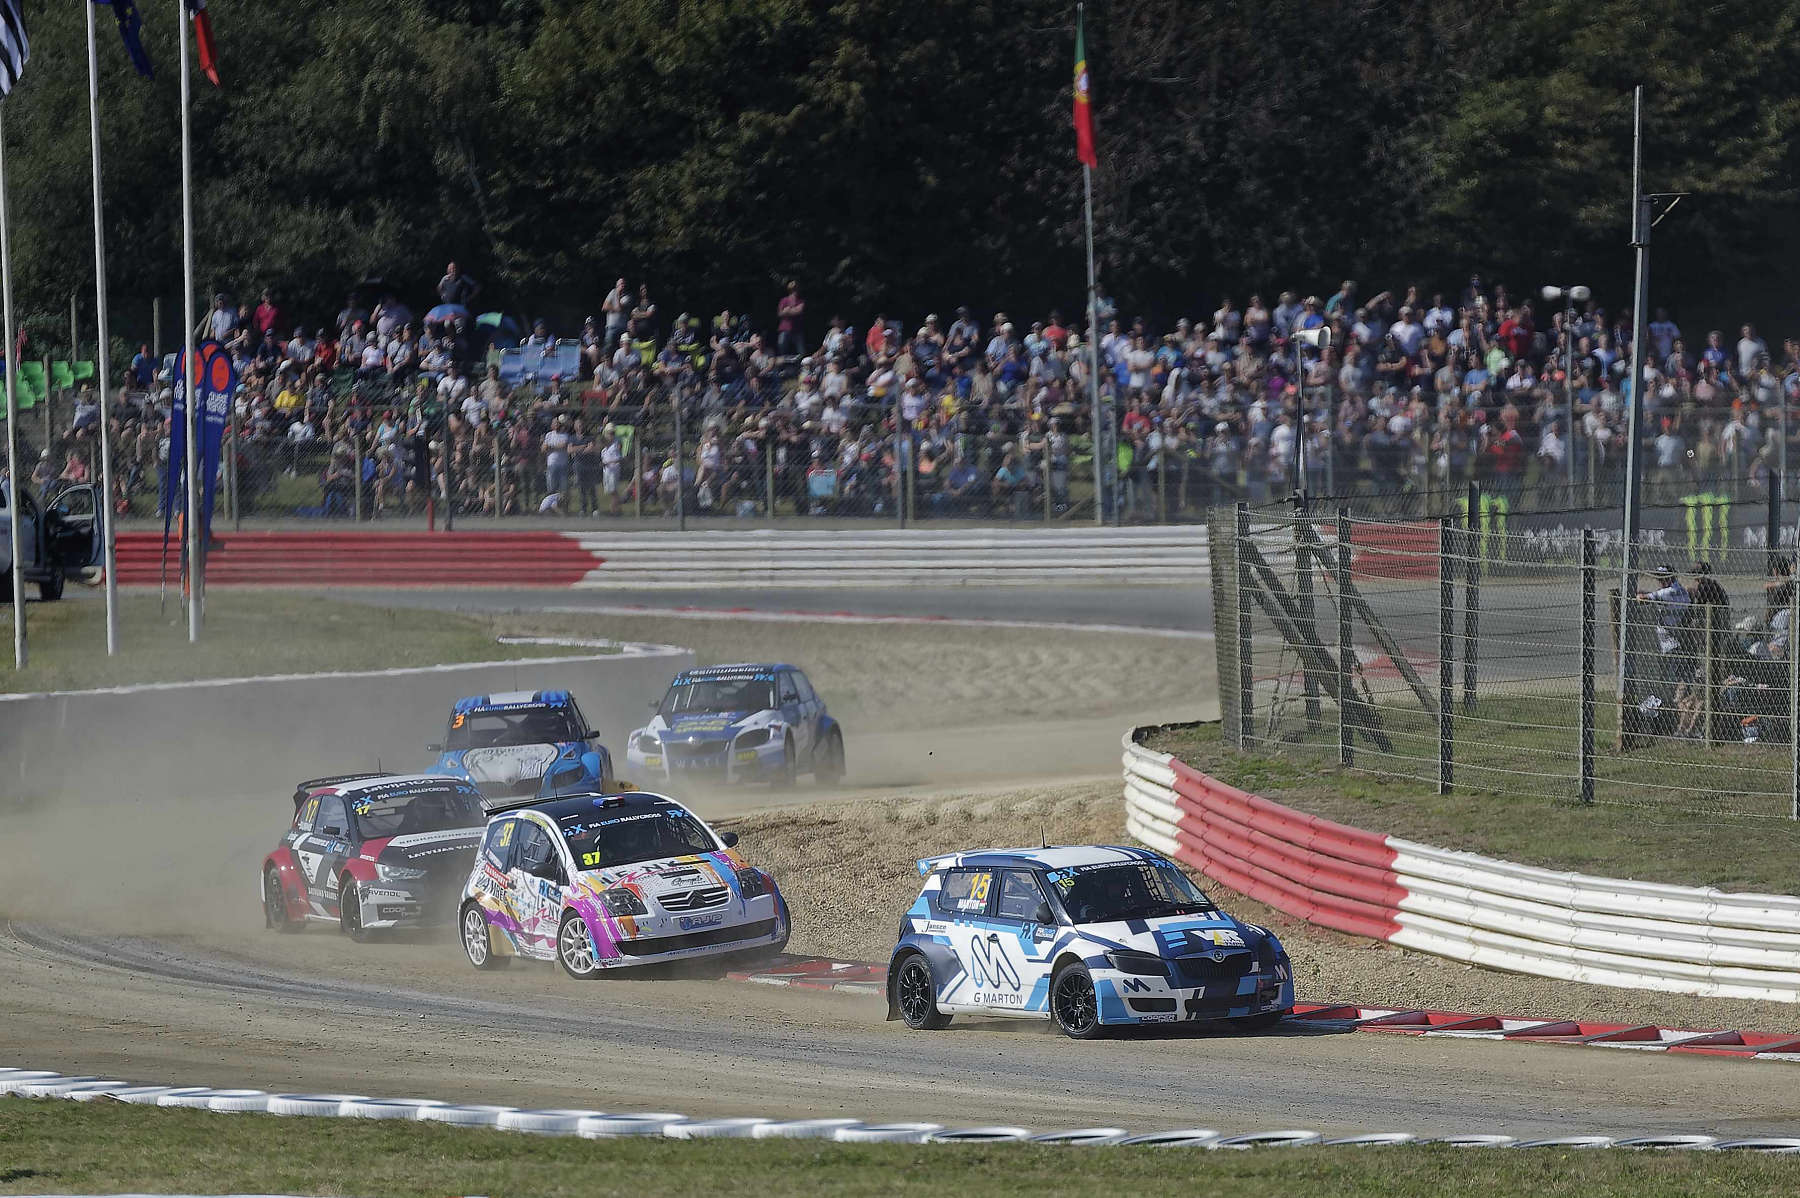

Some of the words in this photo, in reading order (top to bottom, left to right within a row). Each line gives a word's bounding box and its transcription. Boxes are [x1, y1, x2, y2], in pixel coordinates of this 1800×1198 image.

[451, 714, 465, 729] 3
[409, 785, 451, 796] RALLYCROSS
[304, 799, 320, 823] 17
[356, 804, 372, 816] 17
[588, 821, 601, 829] FIA
[600, 817, 620, 826] EURO
[619, 812, 662, 823] RALLYCROSS
[500, 822, 515, 847] 37
[582, 851, 601, 867] 37
[970, 873, 991, 899] 15
[1058, 877, 1076, 890] 15
[974, 992, 981, 1003] G
[983, 992, 1023, 1005] MARTON
